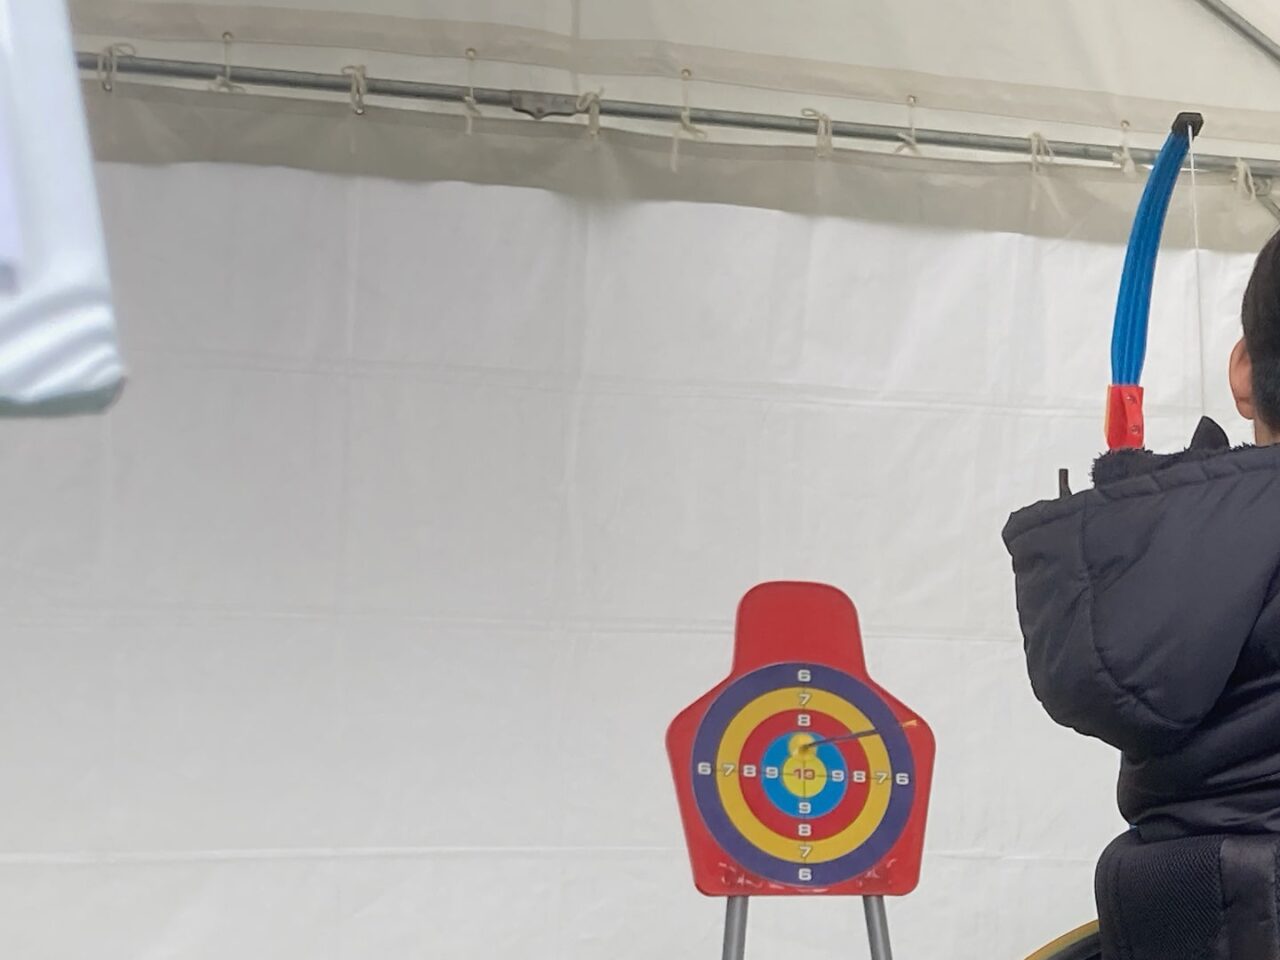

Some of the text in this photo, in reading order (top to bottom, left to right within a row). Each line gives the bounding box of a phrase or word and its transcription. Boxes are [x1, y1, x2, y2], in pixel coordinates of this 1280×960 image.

[797, 669, 811, 682] 6
[799, 694, 811, 705] 7
[797, 714, 811, 726] 8
[697, 762, 711, 775] 6
[722, 765, 735, 776] 7
[743, 765, 756, 777] 8
[853, 770, 866, 783] 8
[876, 772, 889, 784] 7
[895, 773, 909, 785] 6
[798, 824, 812, 836] 8
[799, 846, 811, 858] 7
[798, 868, 812, 881] 6
